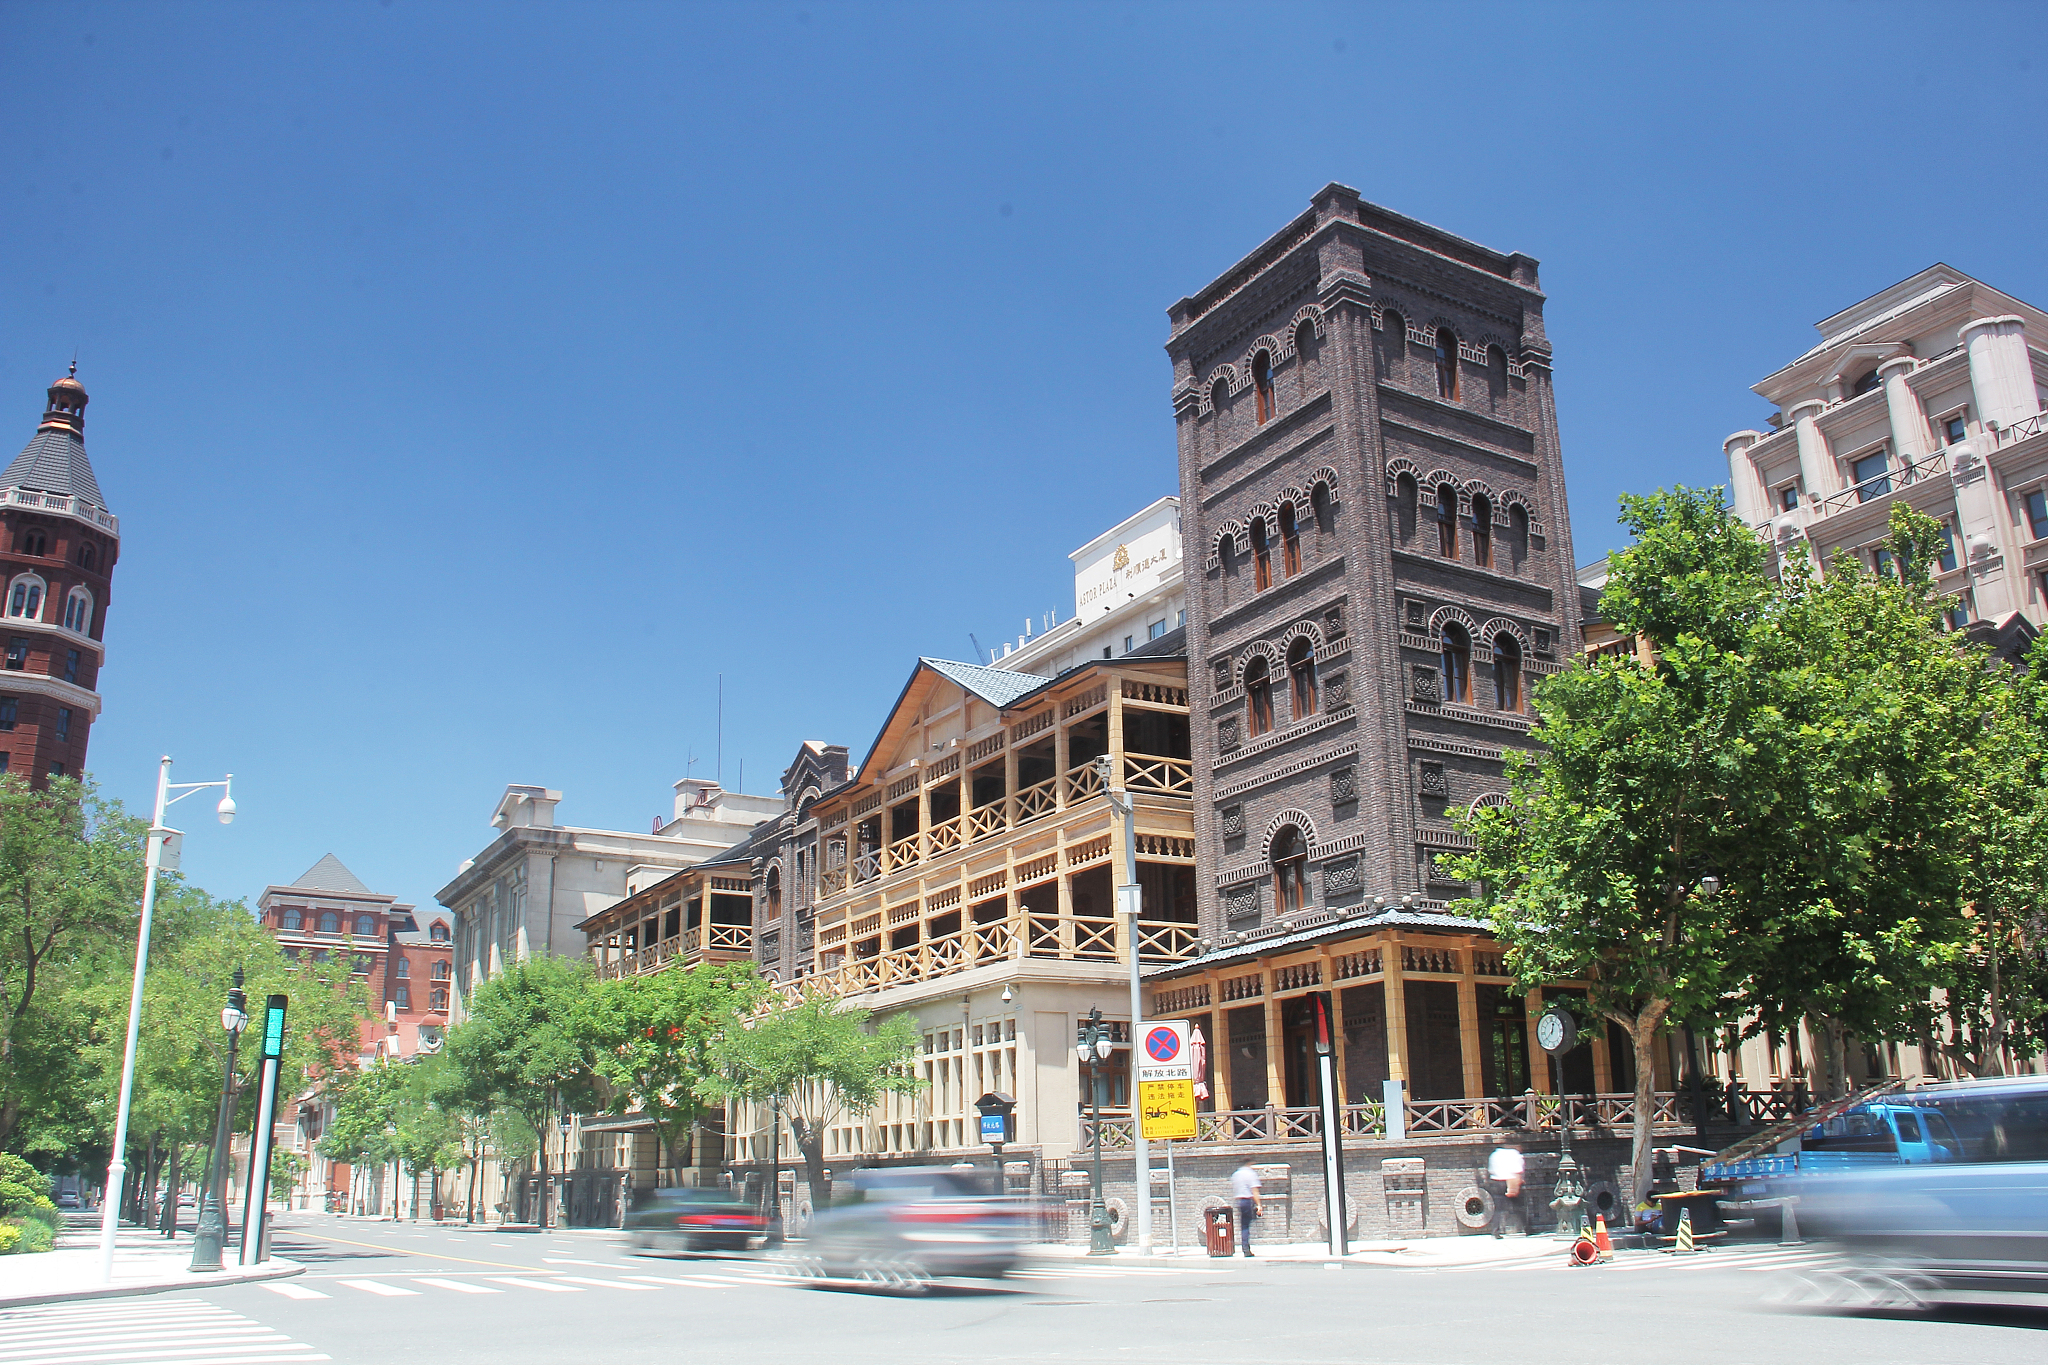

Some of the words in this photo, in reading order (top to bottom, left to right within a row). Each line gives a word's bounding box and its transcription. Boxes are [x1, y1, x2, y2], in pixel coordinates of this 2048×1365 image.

[1080, 587, 1098, 607] ASTOR
[1099, 578, 1118, 597] PLAZA
[1142, 1068, 1188, 1078] 解放北路
[1147, 1083, 1185, 1091] 严禁停车
[1147, 1092, 1185, 1100] 违法拖走
